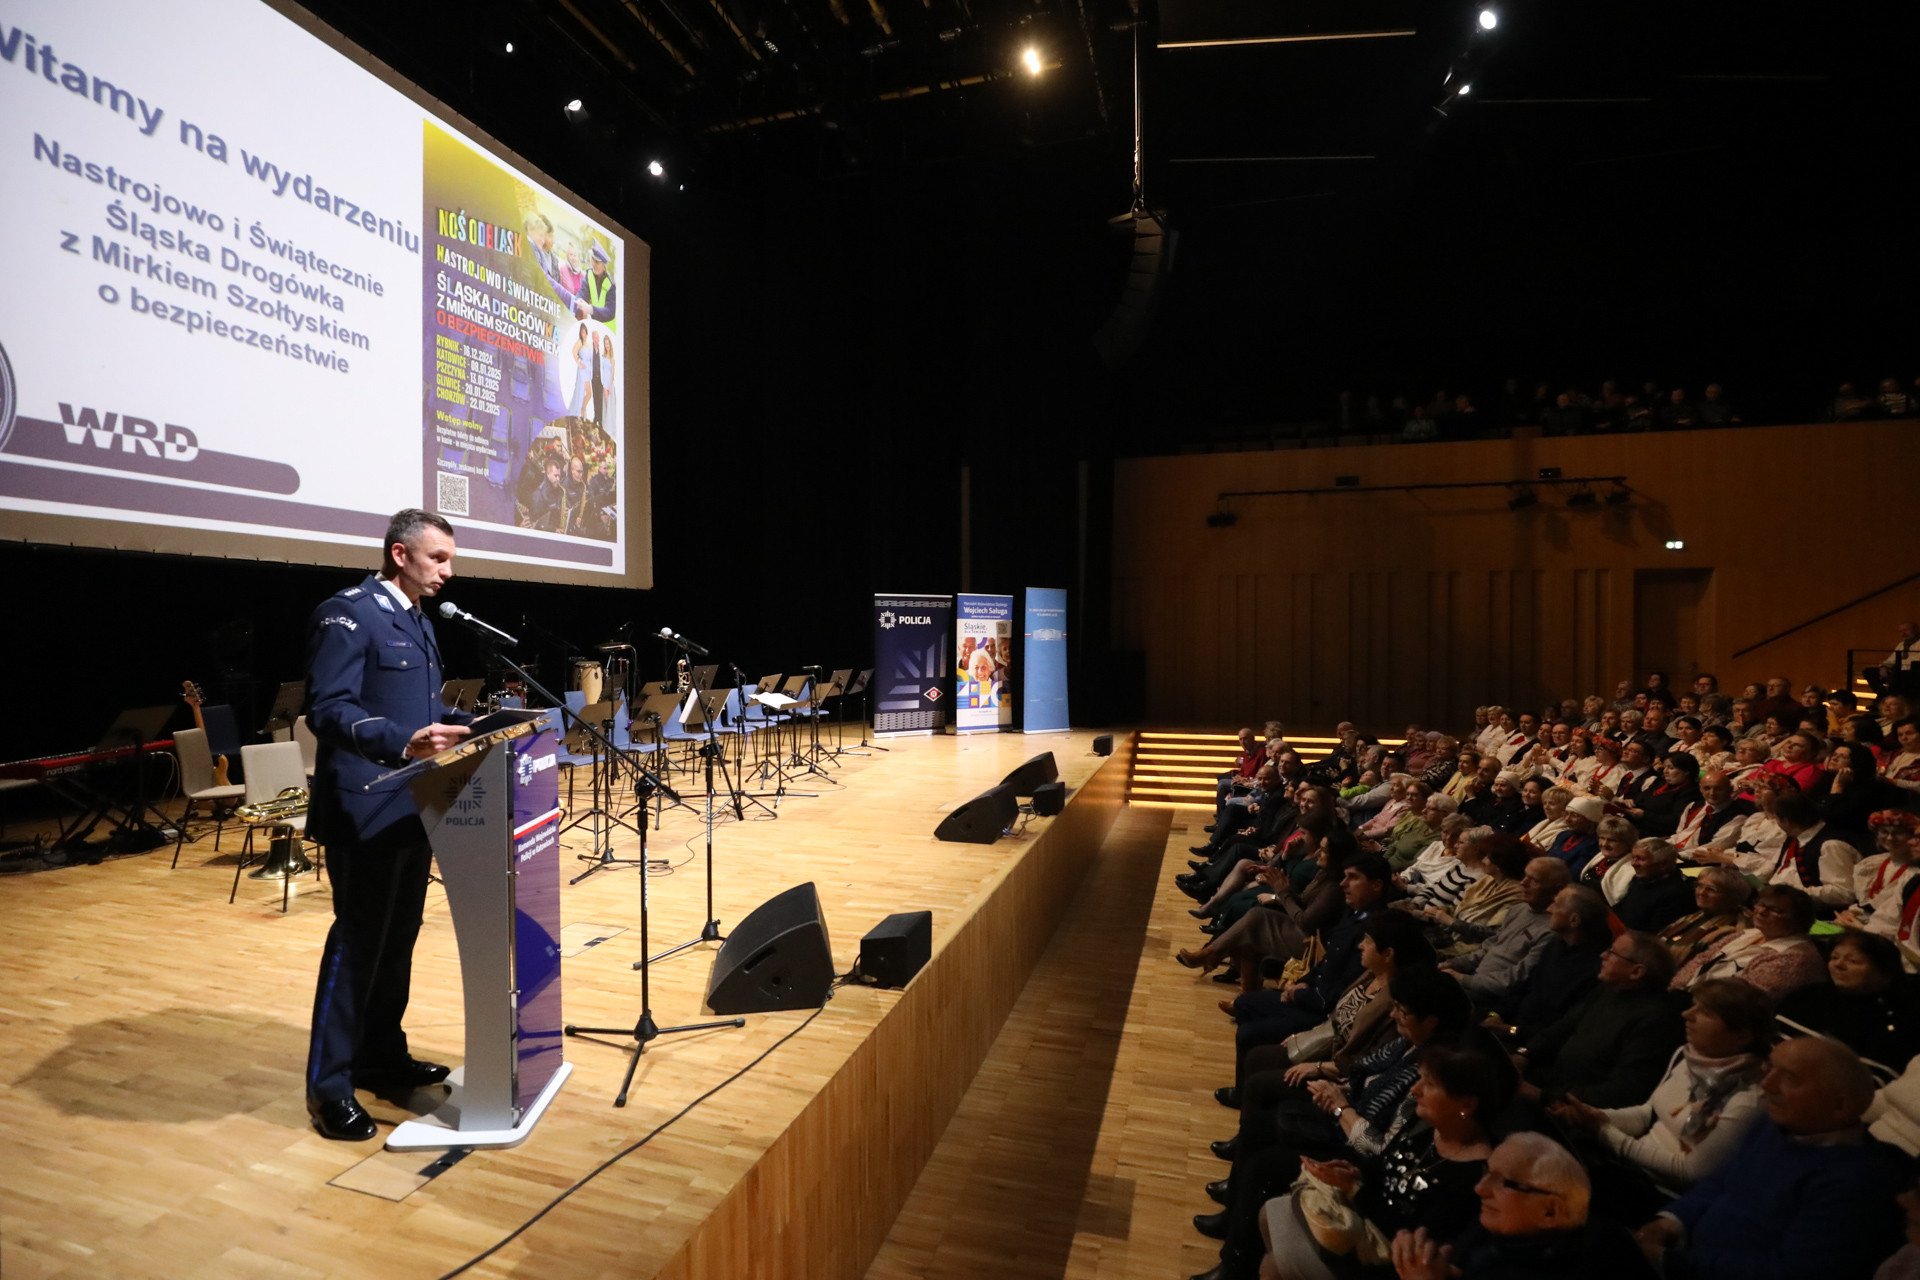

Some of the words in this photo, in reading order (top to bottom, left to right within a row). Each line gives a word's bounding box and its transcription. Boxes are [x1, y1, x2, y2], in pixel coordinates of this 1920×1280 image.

[180, 120, 228, 164] na
[241, 149, 420, 254] wydarzeniu
[34, 133, 224, 232] Nastrojowo
[234, 217, 240, 240] i
[249, 221, 384, 297] Świątecznie
[439, 208, 467, 242] NOŚ
[469, 218, 523, 257] ODBLASK
[106, 200, 210, 263] Śląska
[221, 246, 344, 313] Drogówka
[437, 244, 501, 290] NASTROJOWO
[502, 276, 507, 293] I
[507, 276, 561, 319] ŚWIĄTECZNIE
[60, 230, 80, 254] z
[92, 235, 217, 300] Mirkiem
[227, 283, 370, 351] Szołtyskiem
[436, 270, 491, 312] ŚLĄSKA
[492, 298, 560, 342] DROGÓWKA
[98, 283, 119, 304] o
[131, 286, 350, 374] bezpieczeństwie
[436, 293, 445, 309] Z
[446, 300, 494, 330] MIRKIEM
[495, 318, 560, 357] SZOŁTYSKIEM
[436, 310, 446, 326] O
[447, 314, 546, 366] BEZPIECZEŃSTWIE
[436, 334, 460, 353] RYBNIK
[463, 344, 493, 366] 16.12.2024
[436, 347, 467, 368] KATOWICE
[470, 360, 502, 381] 08.01.2025
[436, 360, 467, 381] PSZCZYNA
[470, 372, 499, 392] 13.01.2025
[436, 373, 461, 391] GLIWICE
[464, 383, 496, 403] 20.01.2025
[436, 386, 466, 406] CHORZÓW
[470, 397, 500, 416] 22.01.2025
[436, 410, 461, 426] Wstęp
[462, 420, 484, 433] wolny
[58, 401, 199, 463] WRD
[898, 616, 932, 625] POLICJA
[963, 606, 988, 615] Wojciech
[445, 817, 486, 826] POLICJA
